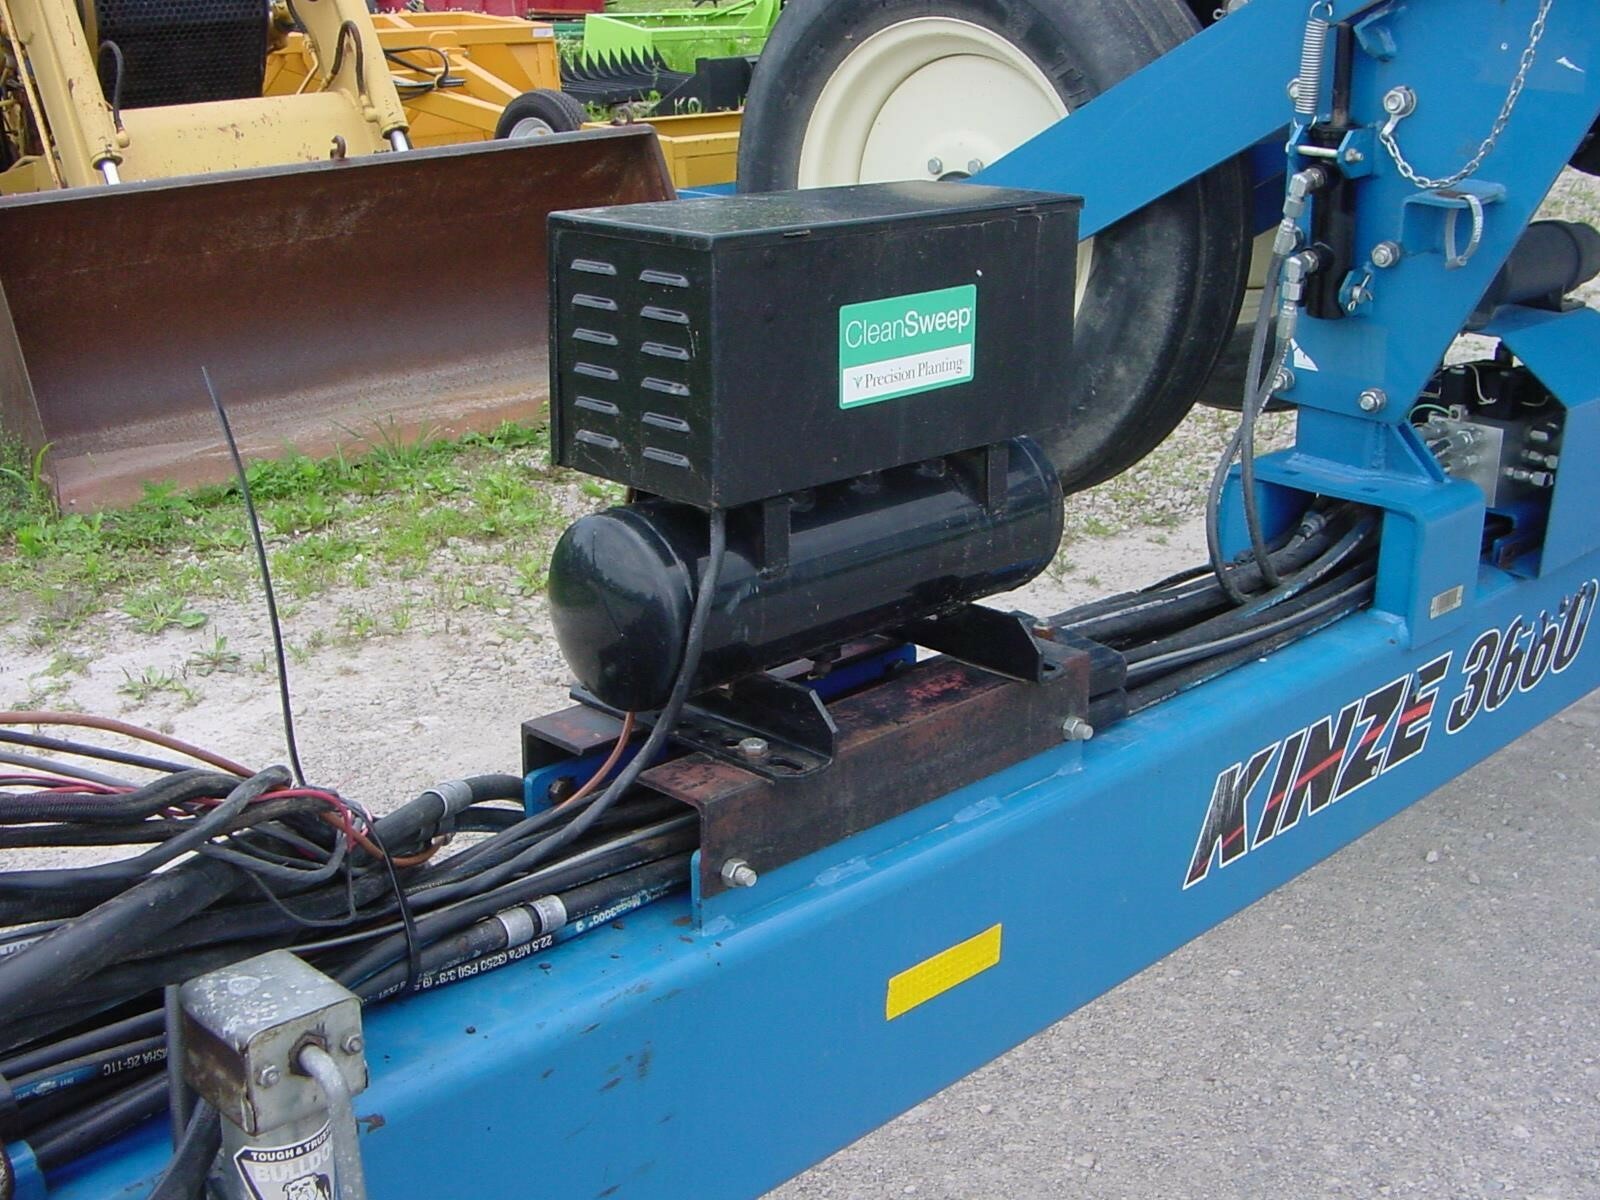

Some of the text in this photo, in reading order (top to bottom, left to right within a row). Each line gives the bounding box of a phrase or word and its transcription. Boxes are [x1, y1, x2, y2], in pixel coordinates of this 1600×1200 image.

[845, 306, 971, 348] CleanSweep
[865, 358, 963, 389] Precision Planting
[1183, 579, 1599, 890] KINZE 3660
[532, 934, 553, 951] 22.5
[508, 945, 531, 960] MPa
[458, 963, 478, 976] PSI)
[480, 953, 507, 972] (3250
[251, 1148, 294, 1162] TOUGH
[295, 1146, 304, 1155] &
